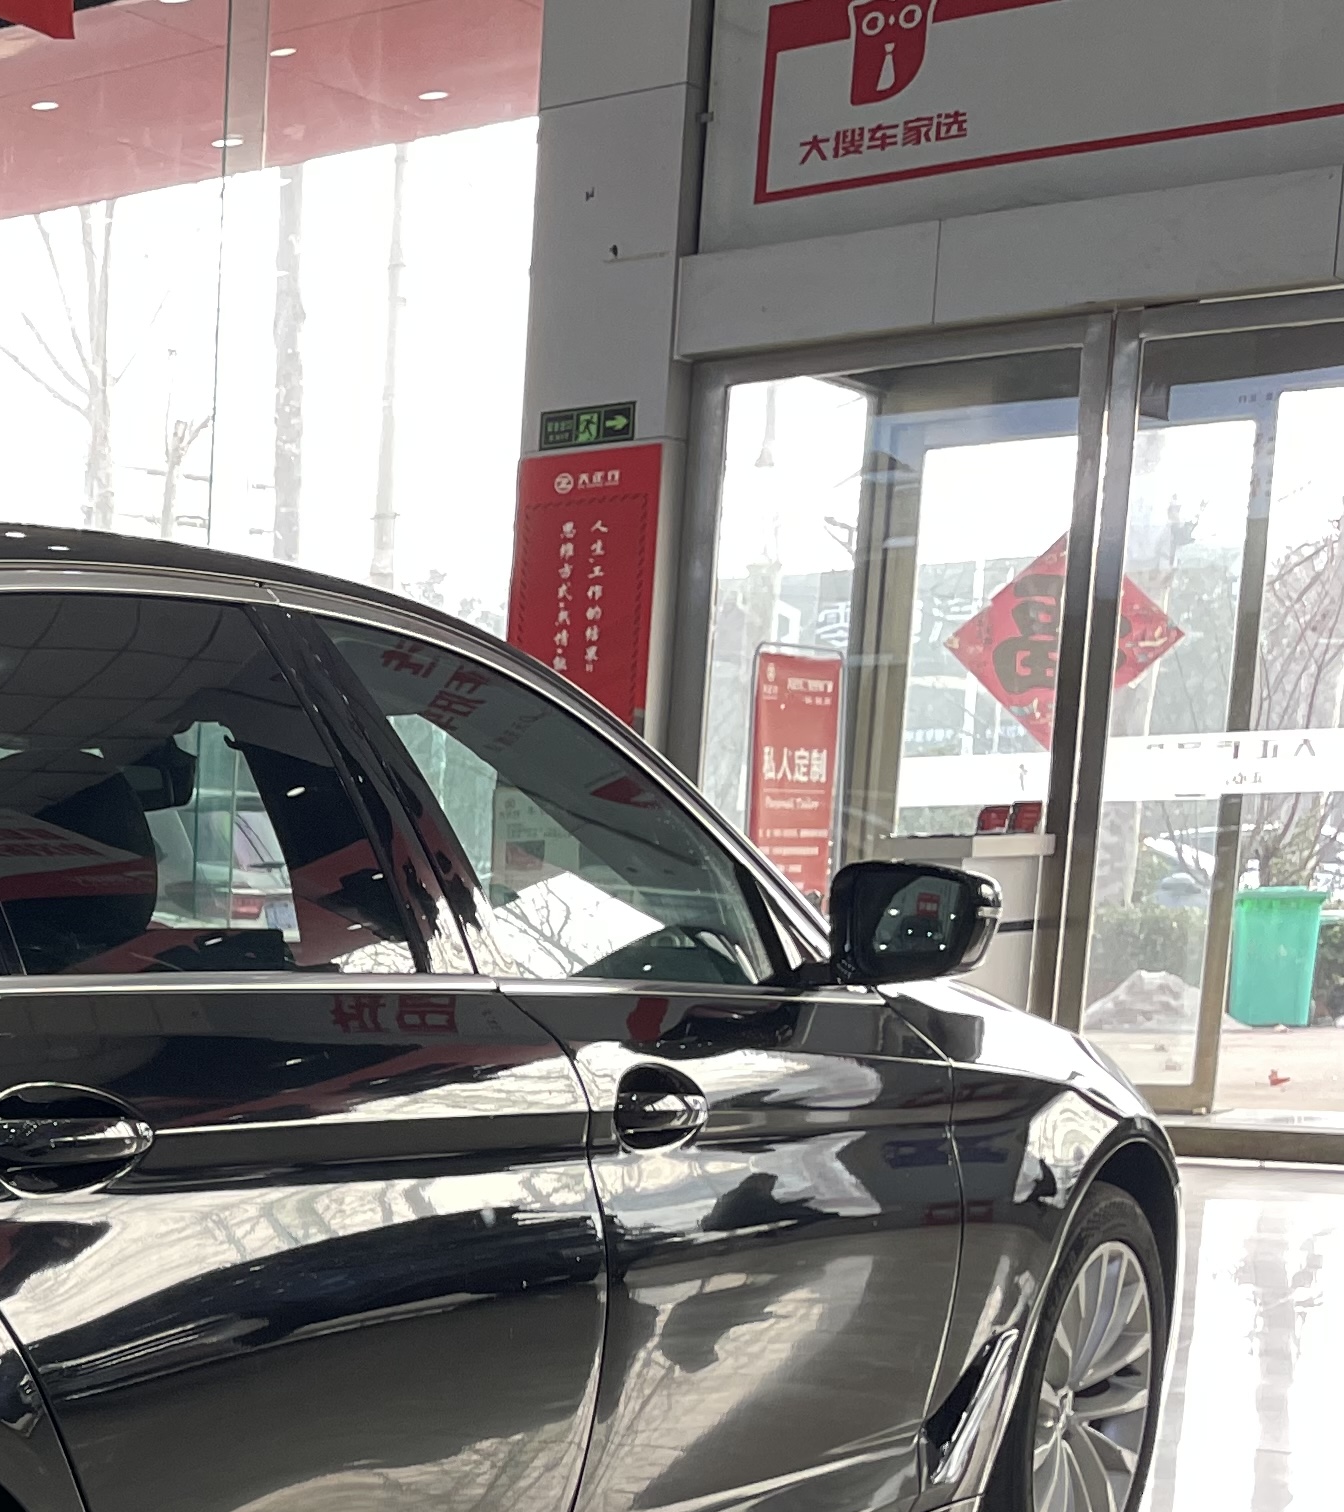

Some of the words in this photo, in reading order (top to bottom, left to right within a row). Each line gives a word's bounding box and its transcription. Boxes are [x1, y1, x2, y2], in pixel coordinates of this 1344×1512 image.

[798, 111, 968, 166] 大搜车家选
[763, 746, 827, 783] 私人定制
